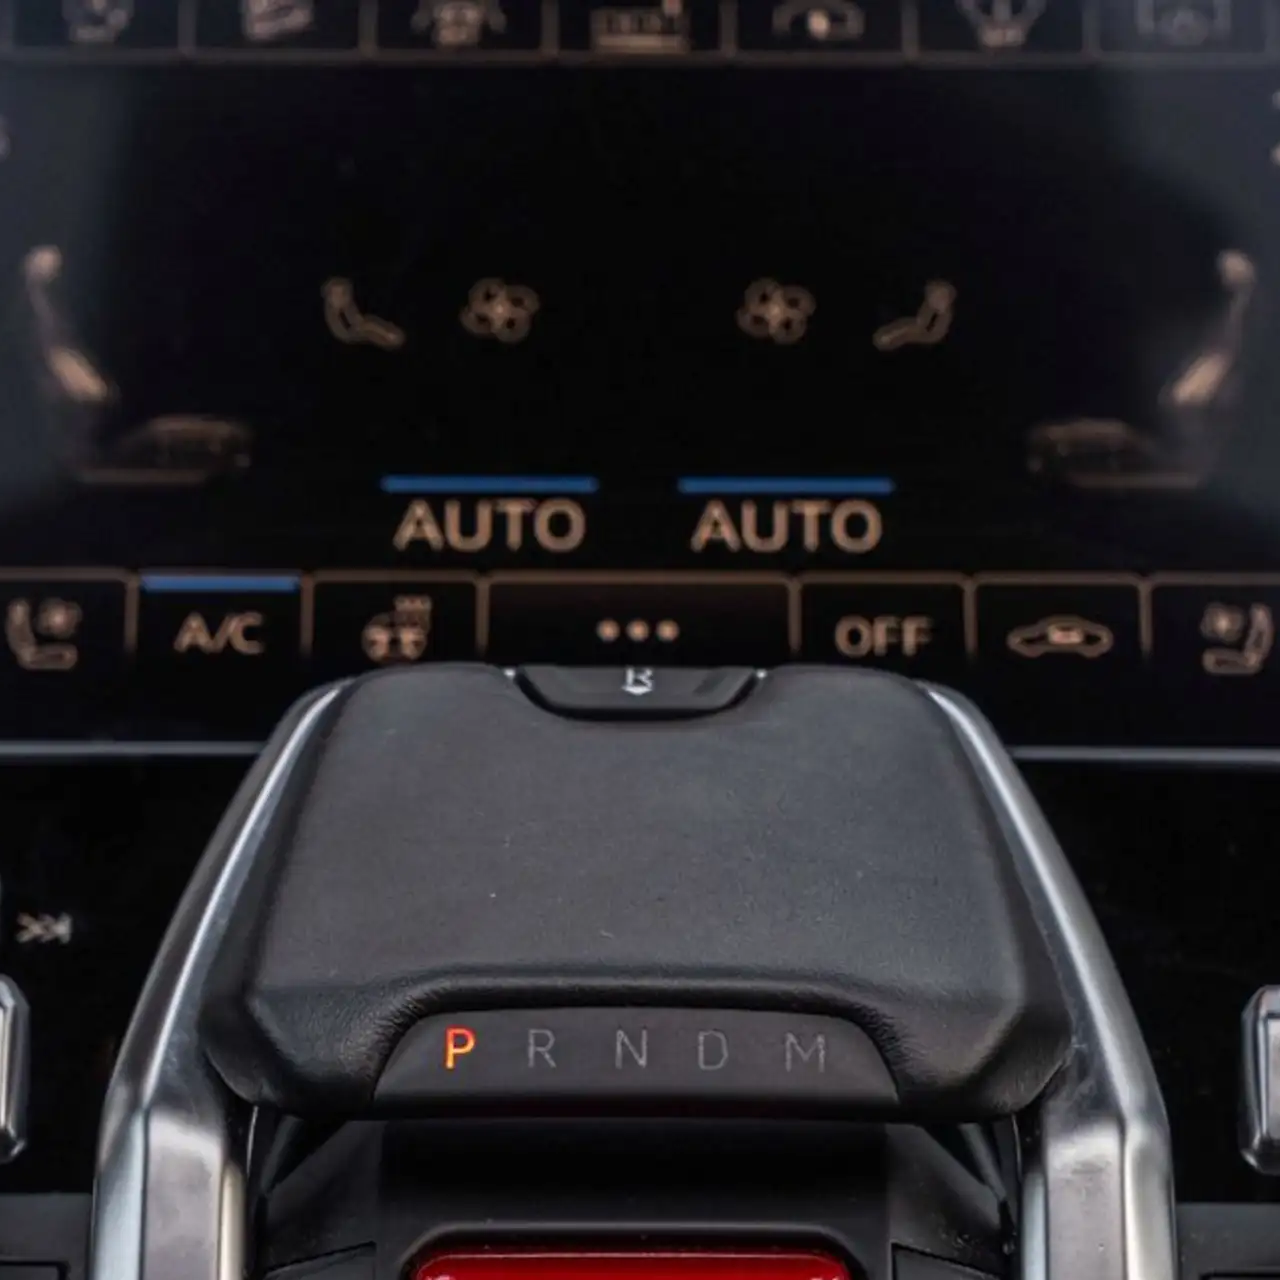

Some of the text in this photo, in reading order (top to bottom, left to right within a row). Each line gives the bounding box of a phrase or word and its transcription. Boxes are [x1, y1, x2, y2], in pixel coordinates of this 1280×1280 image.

[394, 499, 585, 551] AUTO
[691, 500, 882, 552] AUTO
[174, 612, 264, 654] A/C
[834, 615, 932, 655] OFF
[445, 1027, 826, 1072] P R N D M
